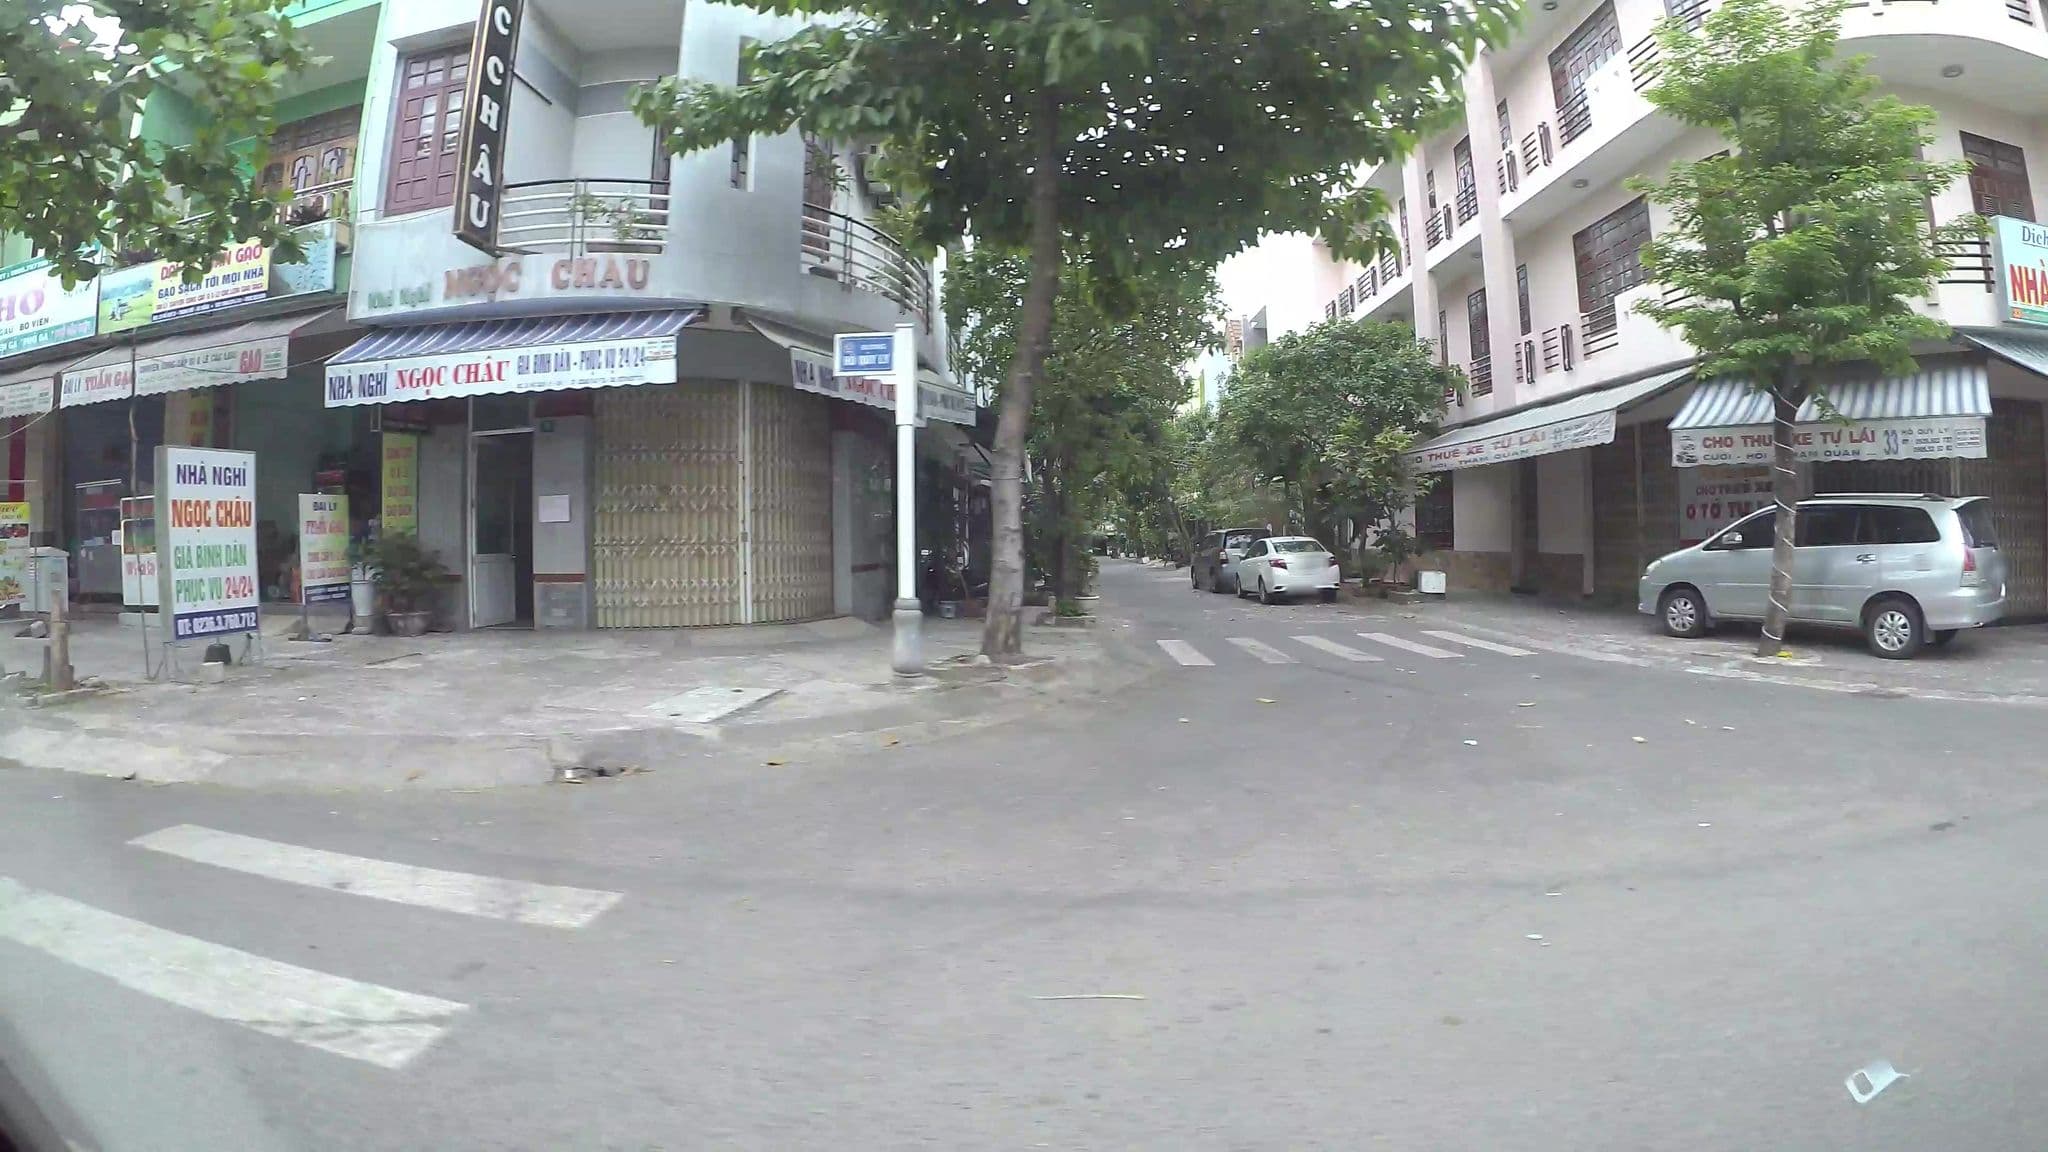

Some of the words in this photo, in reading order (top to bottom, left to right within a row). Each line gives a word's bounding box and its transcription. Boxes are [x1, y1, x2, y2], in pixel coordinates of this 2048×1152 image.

[328, 370, 353, 401] NHÀ
[358, 363, 388, 398] NGHỈ
[395, 366, 447, 396] NGỌC
[453, 355, 510, 384] CHÂU
[1702, 435, 1734, 449] CHO
[1741, 433, 1775, 447] THU
[176, 460, 208, 485] NHÀ
[212, 461, 247, 487] NGHỈ
[172, 499, 212, 533] NGỌC
[216, 495, 251, 528] CHÂU
[174, 540, 194, 569] GIÁ
[175, 576, 206, 608] PHỤC
[208, 578, 223, 605] VỤ
[225, 575, 254, 600] 24/24
